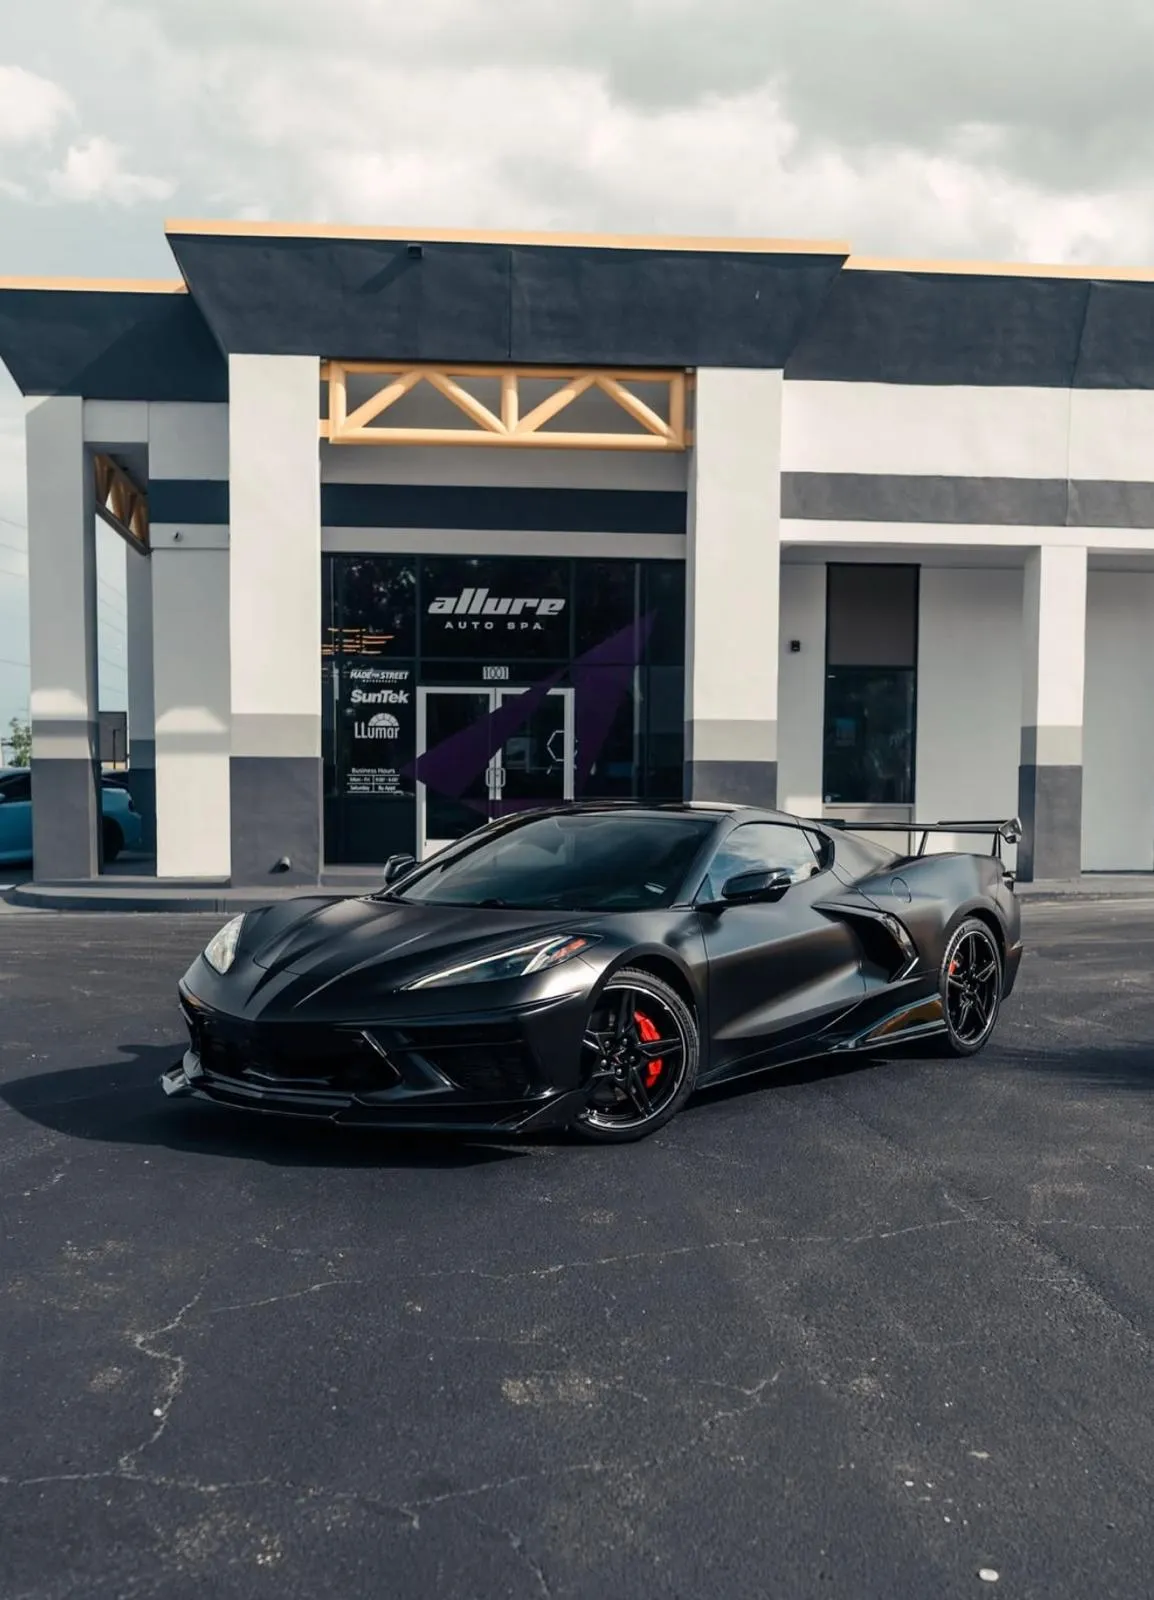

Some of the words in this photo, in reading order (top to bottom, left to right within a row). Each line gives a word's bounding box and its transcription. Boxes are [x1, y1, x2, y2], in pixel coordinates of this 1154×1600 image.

[427, 588, 566, 615] allure
[444, 621, 494, 630] AUTO
[507, 622, 542, 631] SPA
[380, 671, 409, 680] STREET
[350, 689, 409, 704] SunTek
[354, 721, 400, 739] LLumar
